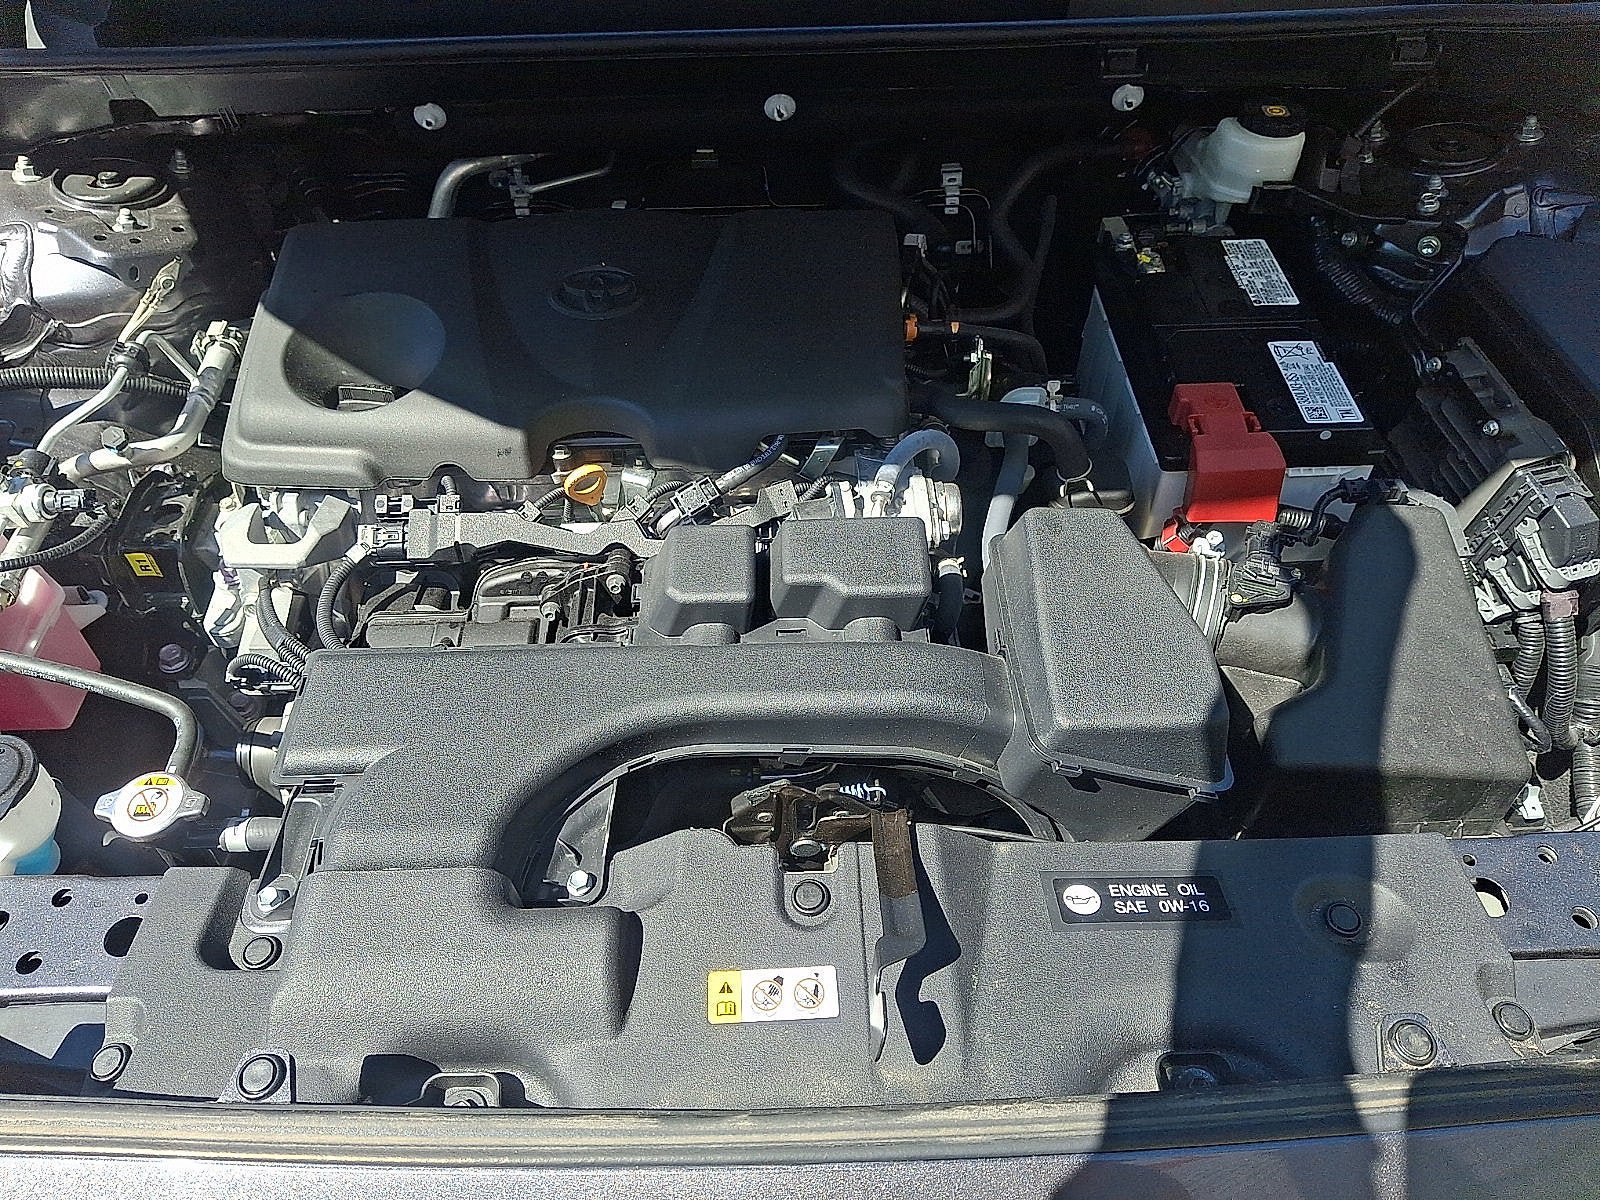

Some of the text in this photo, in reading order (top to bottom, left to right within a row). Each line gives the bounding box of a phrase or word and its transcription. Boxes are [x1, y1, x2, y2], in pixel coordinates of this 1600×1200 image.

[135, 559, 152, 572] R1
[1108, 883, 1206, 897] ENGINE OIL
[1114, 900, 1210, 914] SAE 0W-16
